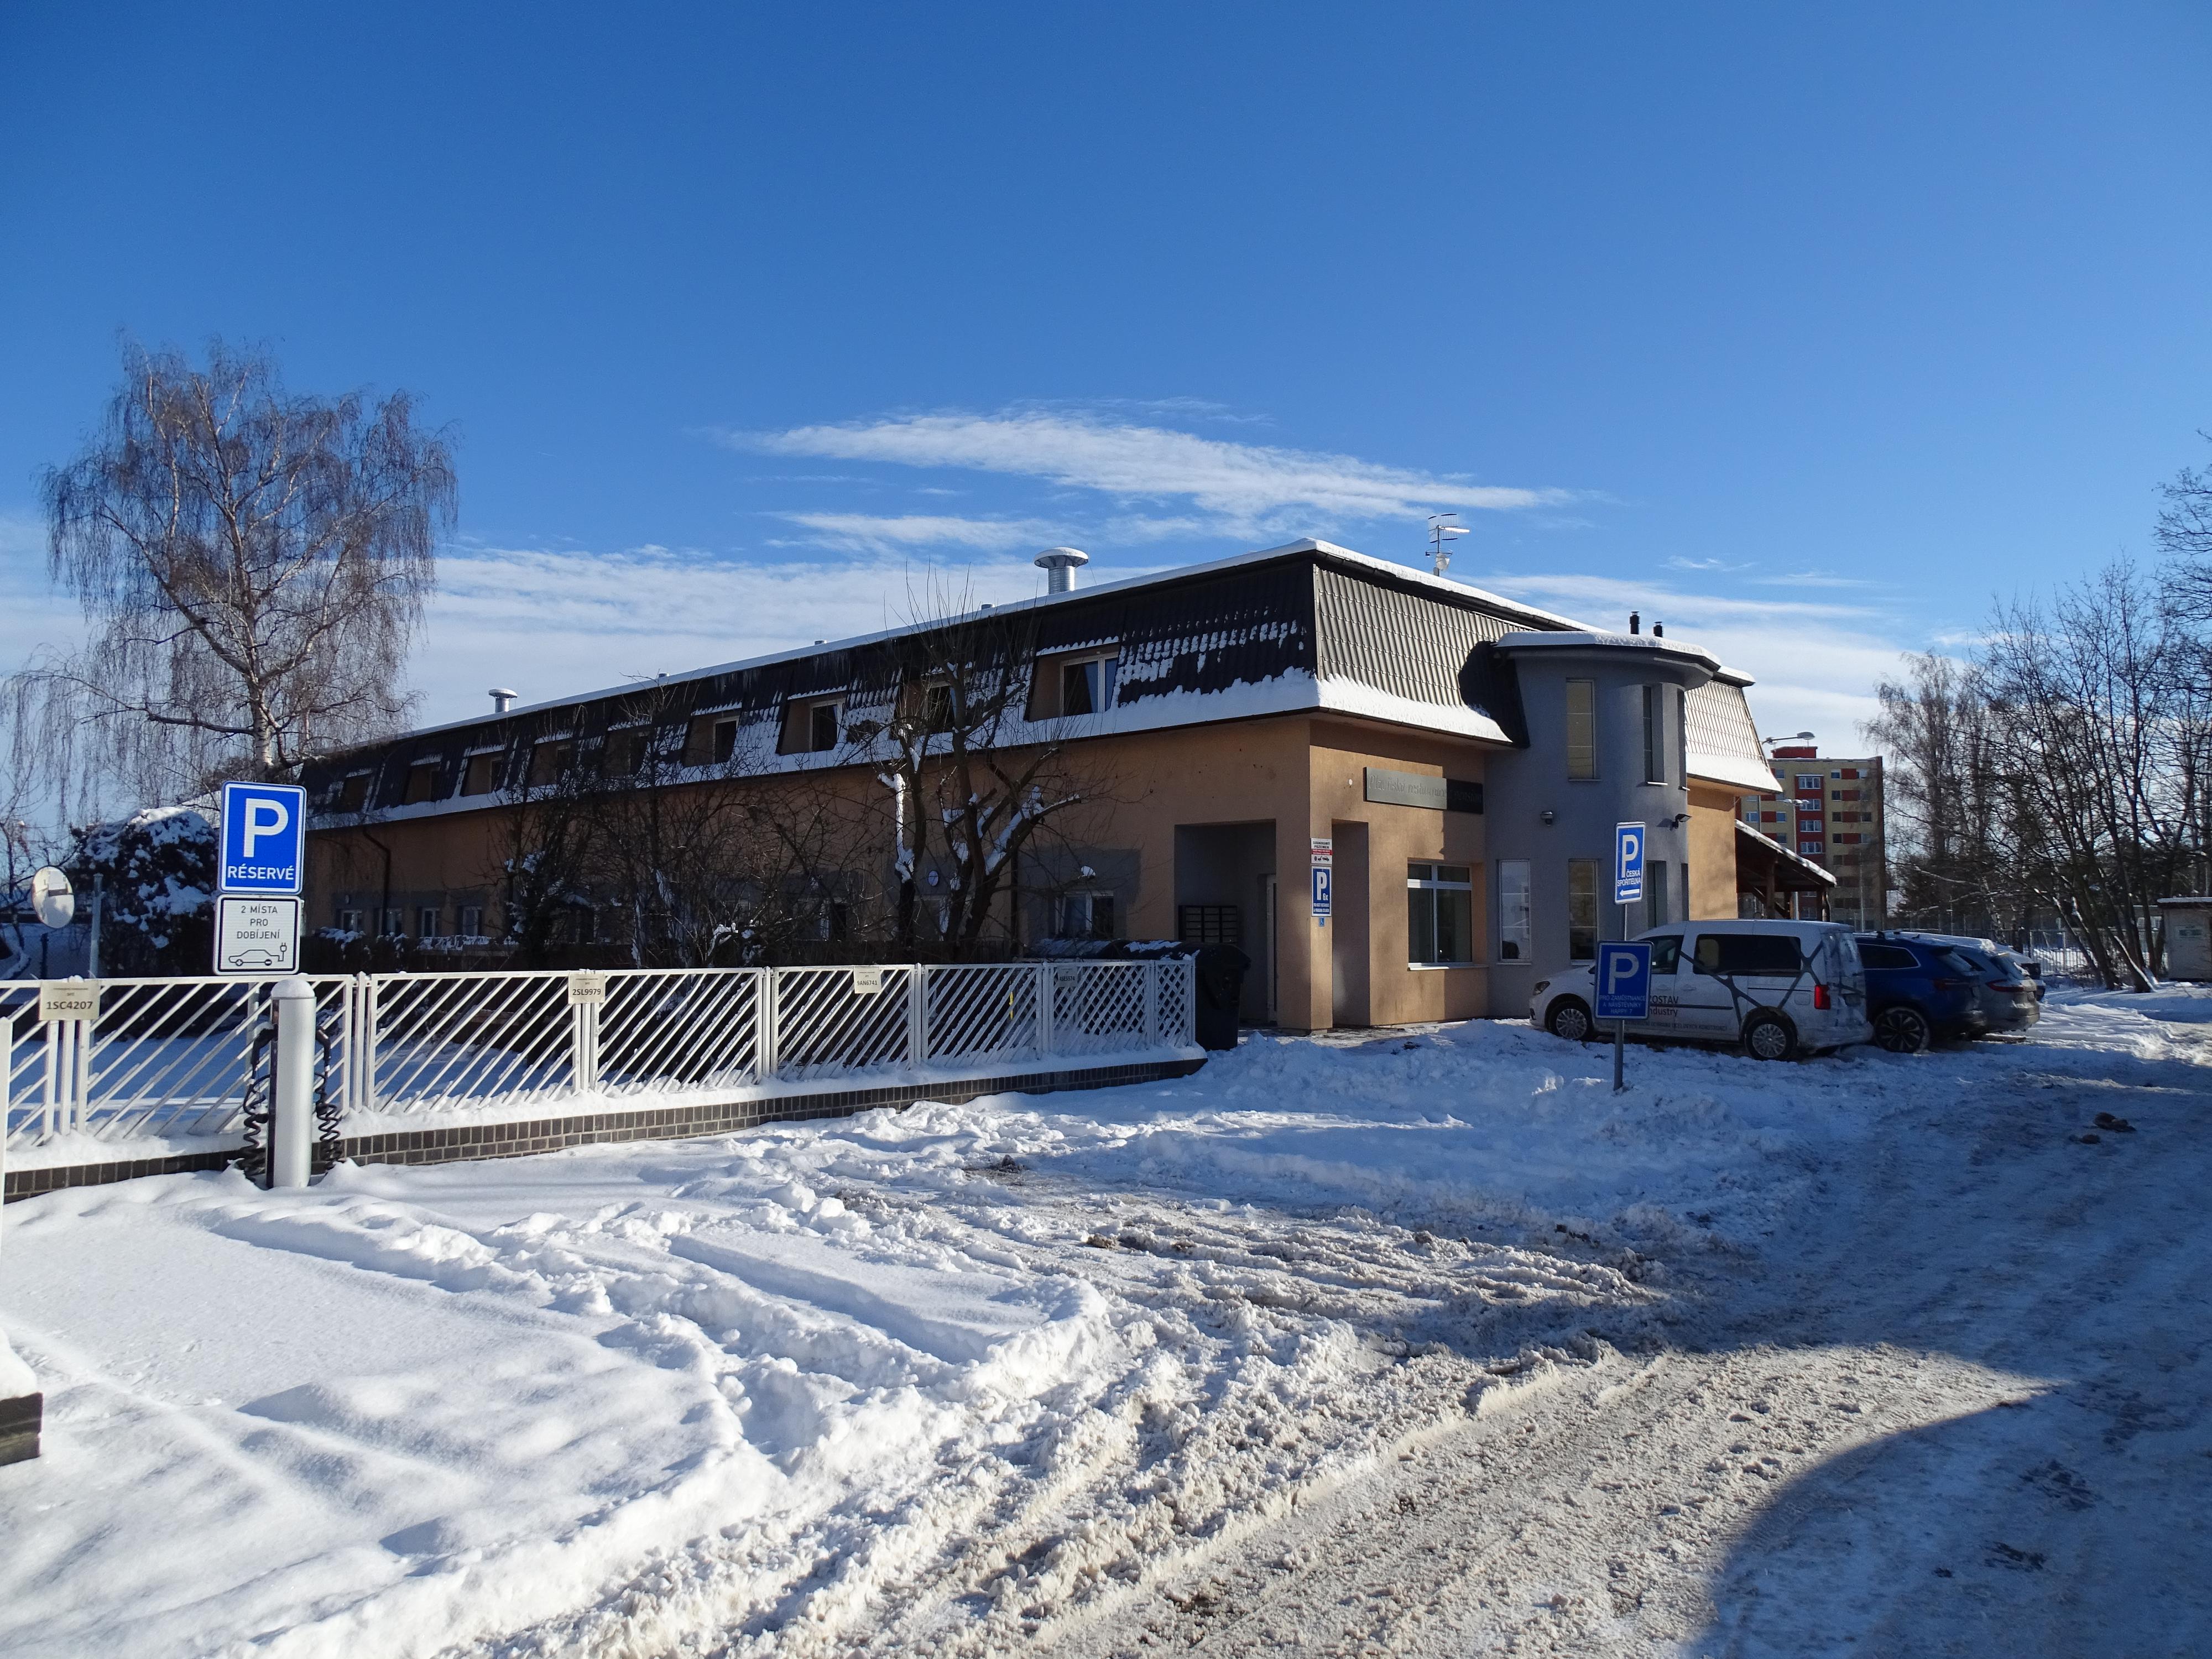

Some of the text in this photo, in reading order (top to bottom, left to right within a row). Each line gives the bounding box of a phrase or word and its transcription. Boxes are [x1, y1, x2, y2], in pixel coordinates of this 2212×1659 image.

[243, 798, 289, 857] P
[1621, 834, 1638, 878] P
[227, 863, 294, 880] RÉSERVÉ
[1626, 868, 1640, 877] ČESKÁ
[1317, 872, 1327, 900] P
[1617, 877, 1641, 886] SPOŘITELNA
[251, 904, 278, 914] MÍSTA
[237, 930, 280, 940] DOBÍJENÍ
[1608, 952, 1639, 994] P
[1650, 995, 1679, 1004] OSTAV
[46, 1001, 93, 1009] 1SC4207
